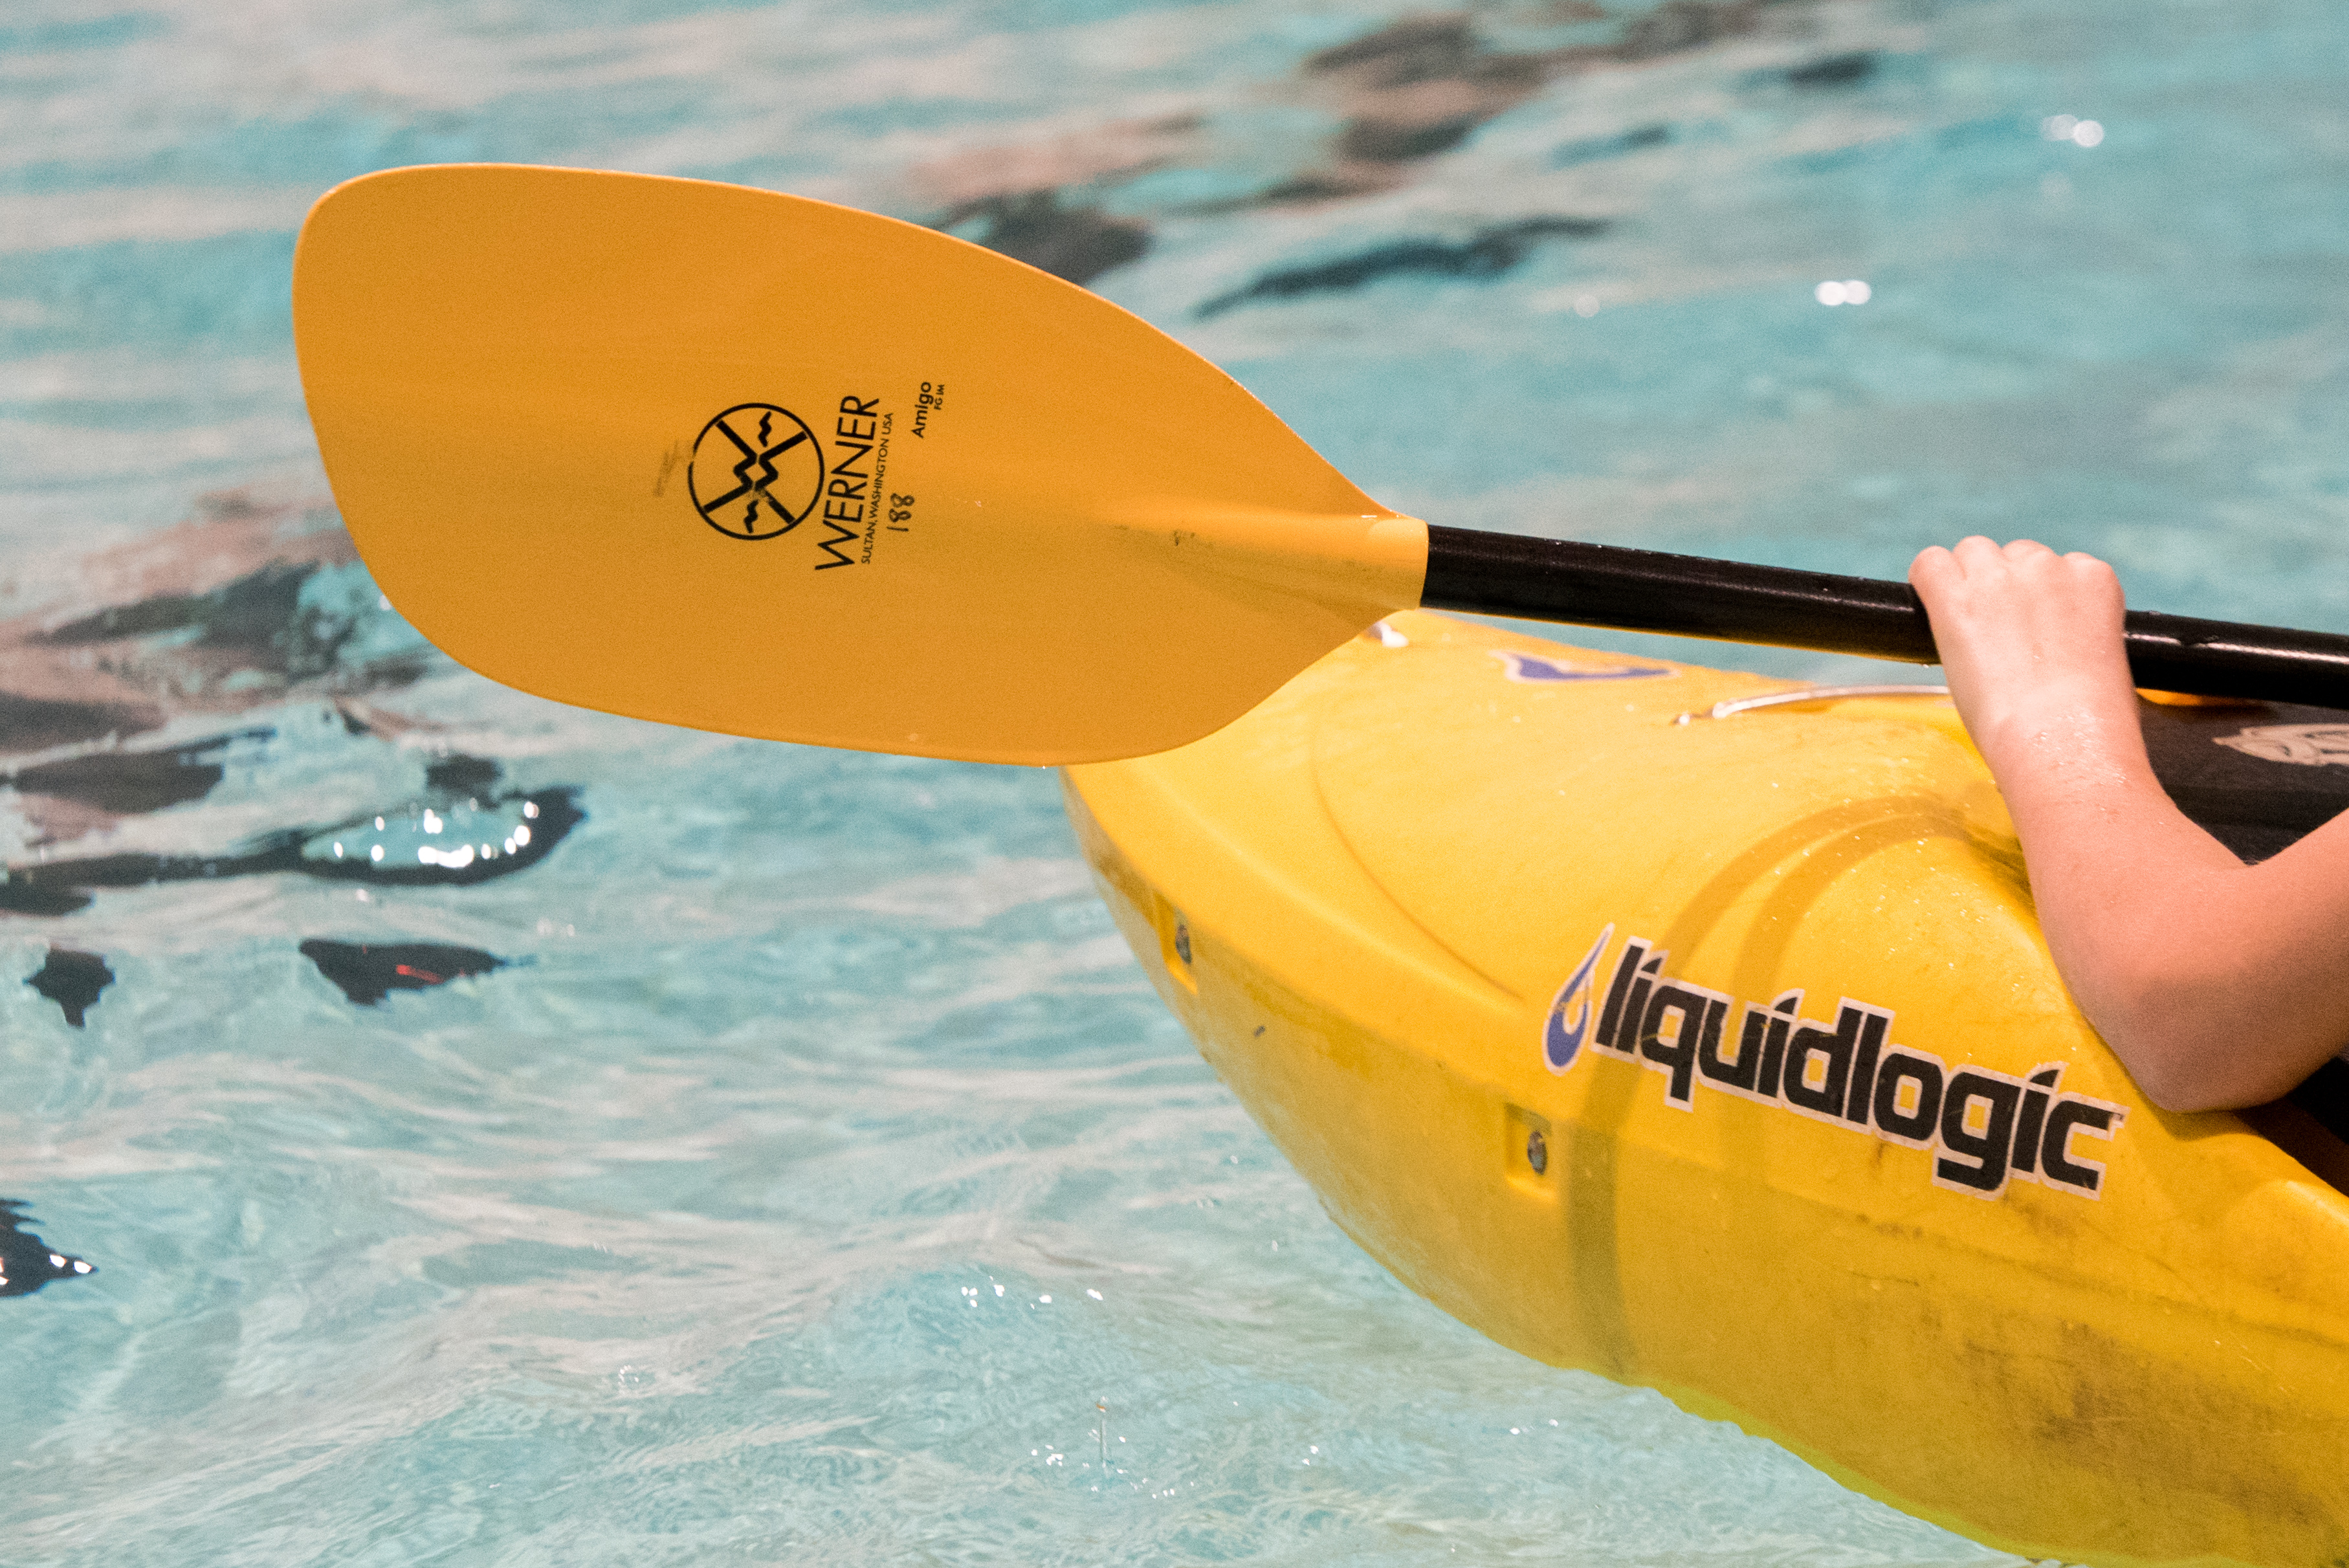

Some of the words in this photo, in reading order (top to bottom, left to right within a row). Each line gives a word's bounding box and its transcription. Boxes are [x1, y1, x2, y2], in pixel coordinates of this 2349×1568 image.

[910, 381, 934, 439] Amigo
[933, 397, 943, 410] FG
[815, 395, 879, 571] WERNER
[868, 438, 890, 518] WASHINGTON
[881, 413, 894, 435] USA
[886, 492, 915, 531] 188
[1593, 942, 2126, 1194] liquidlogic
